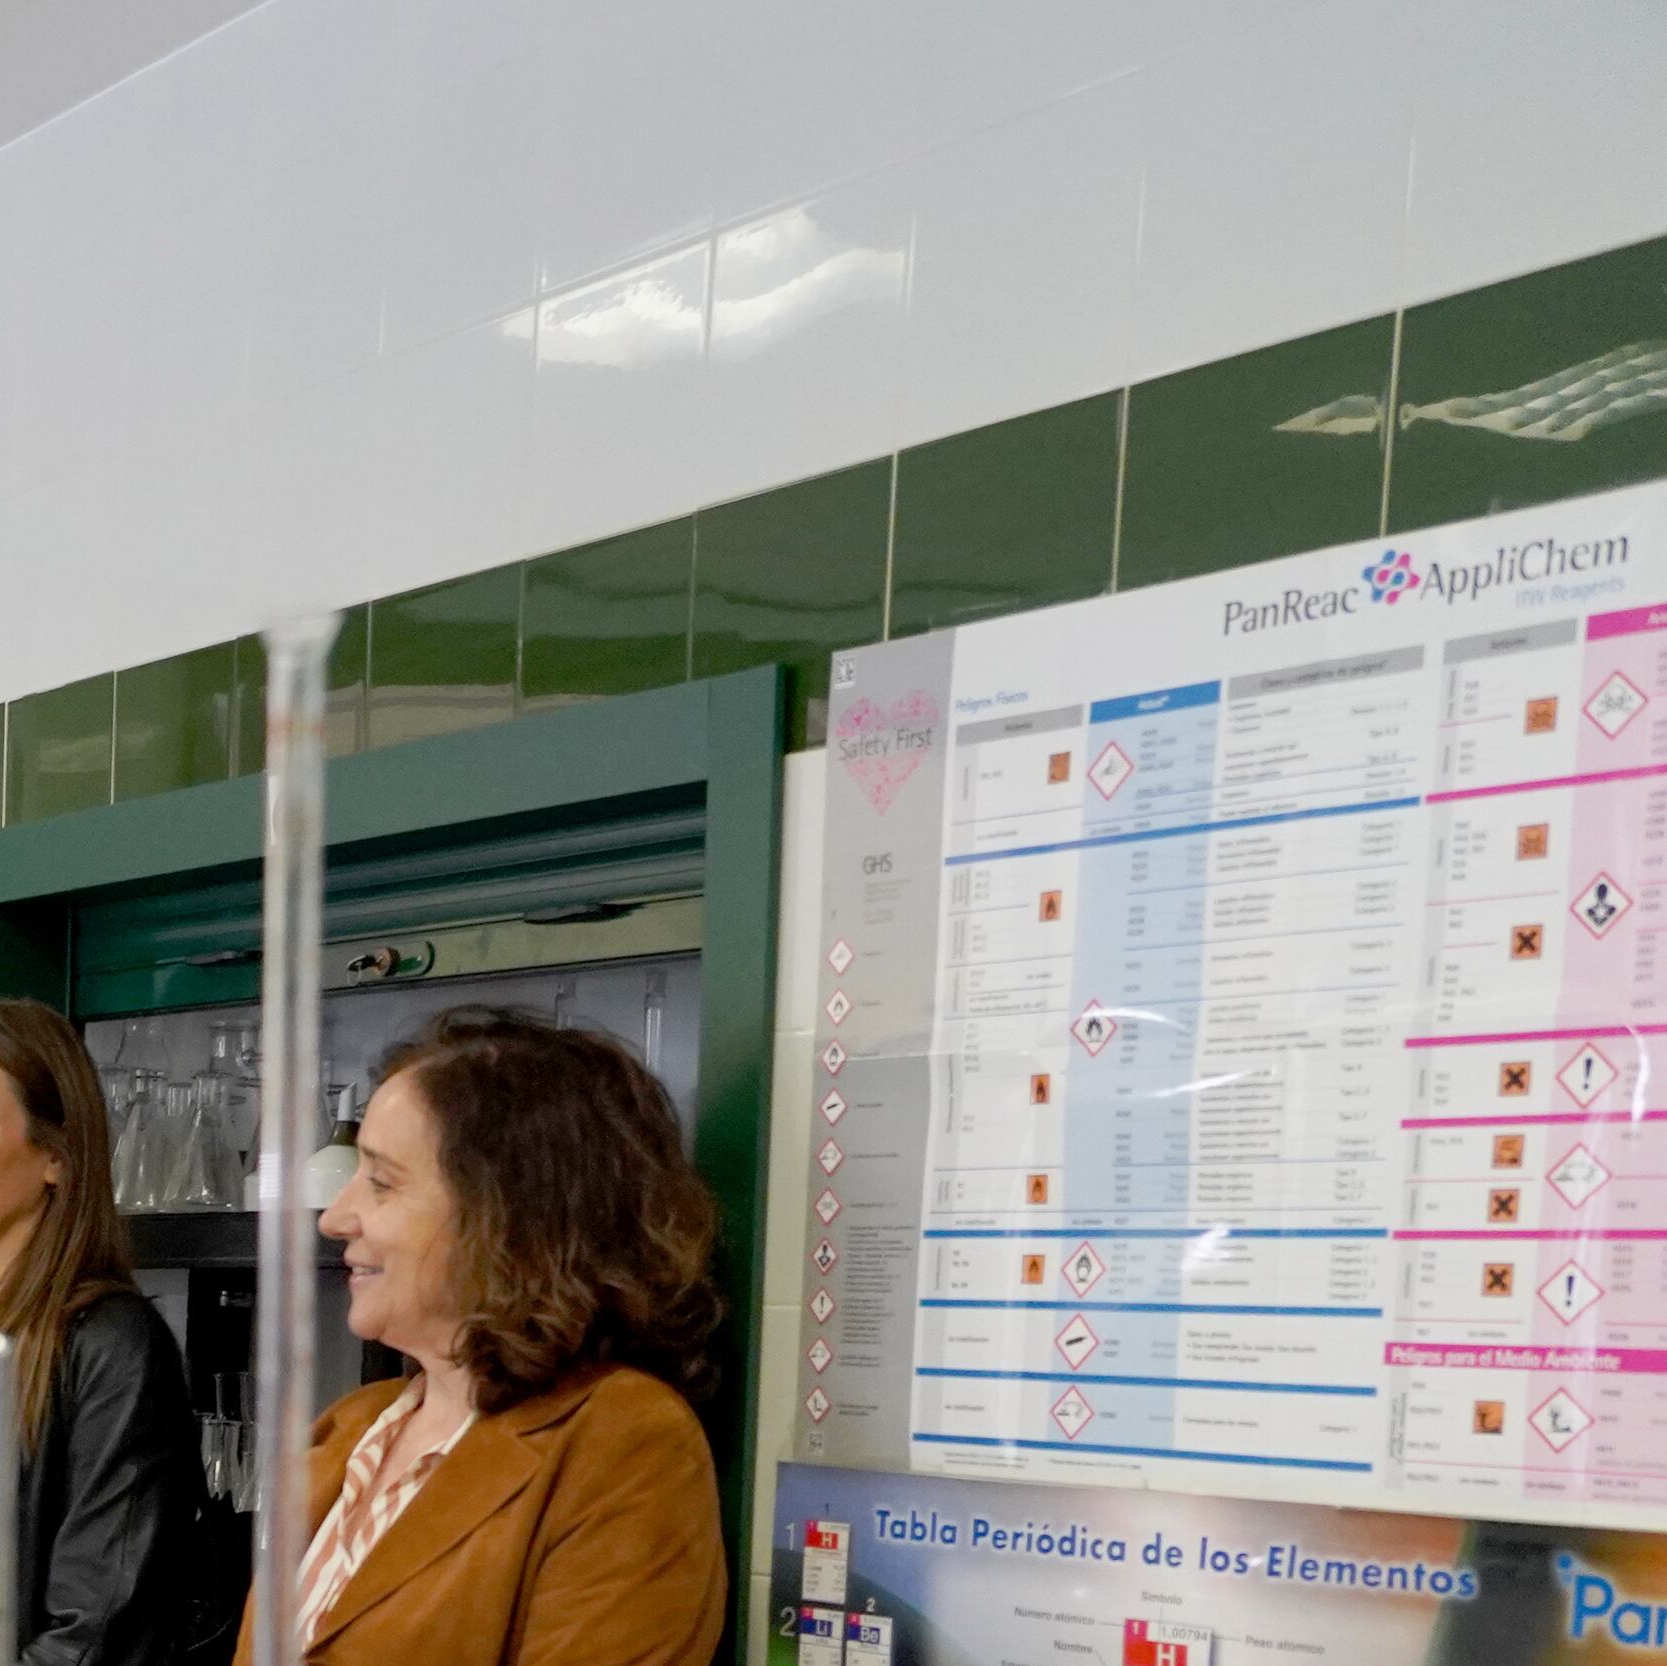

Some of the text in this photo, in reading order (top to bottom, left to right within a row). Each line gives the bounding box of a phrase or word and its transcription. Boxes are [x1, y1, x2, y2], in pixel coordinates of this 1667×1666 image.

[1223, 534, 1630, 636] PanReac AppliChem
[838, 726, 934, 764] Safety First
[862, 852, 893, 876] GHS
[1391, 1347, 1443, 1366] Peligros
[1446, 1351, 1476, 1368] para
[1495, 1351, 1542, 1369] Medio
[875, 1510, 1479, 1598] Tabla Periódica de los Elementos
